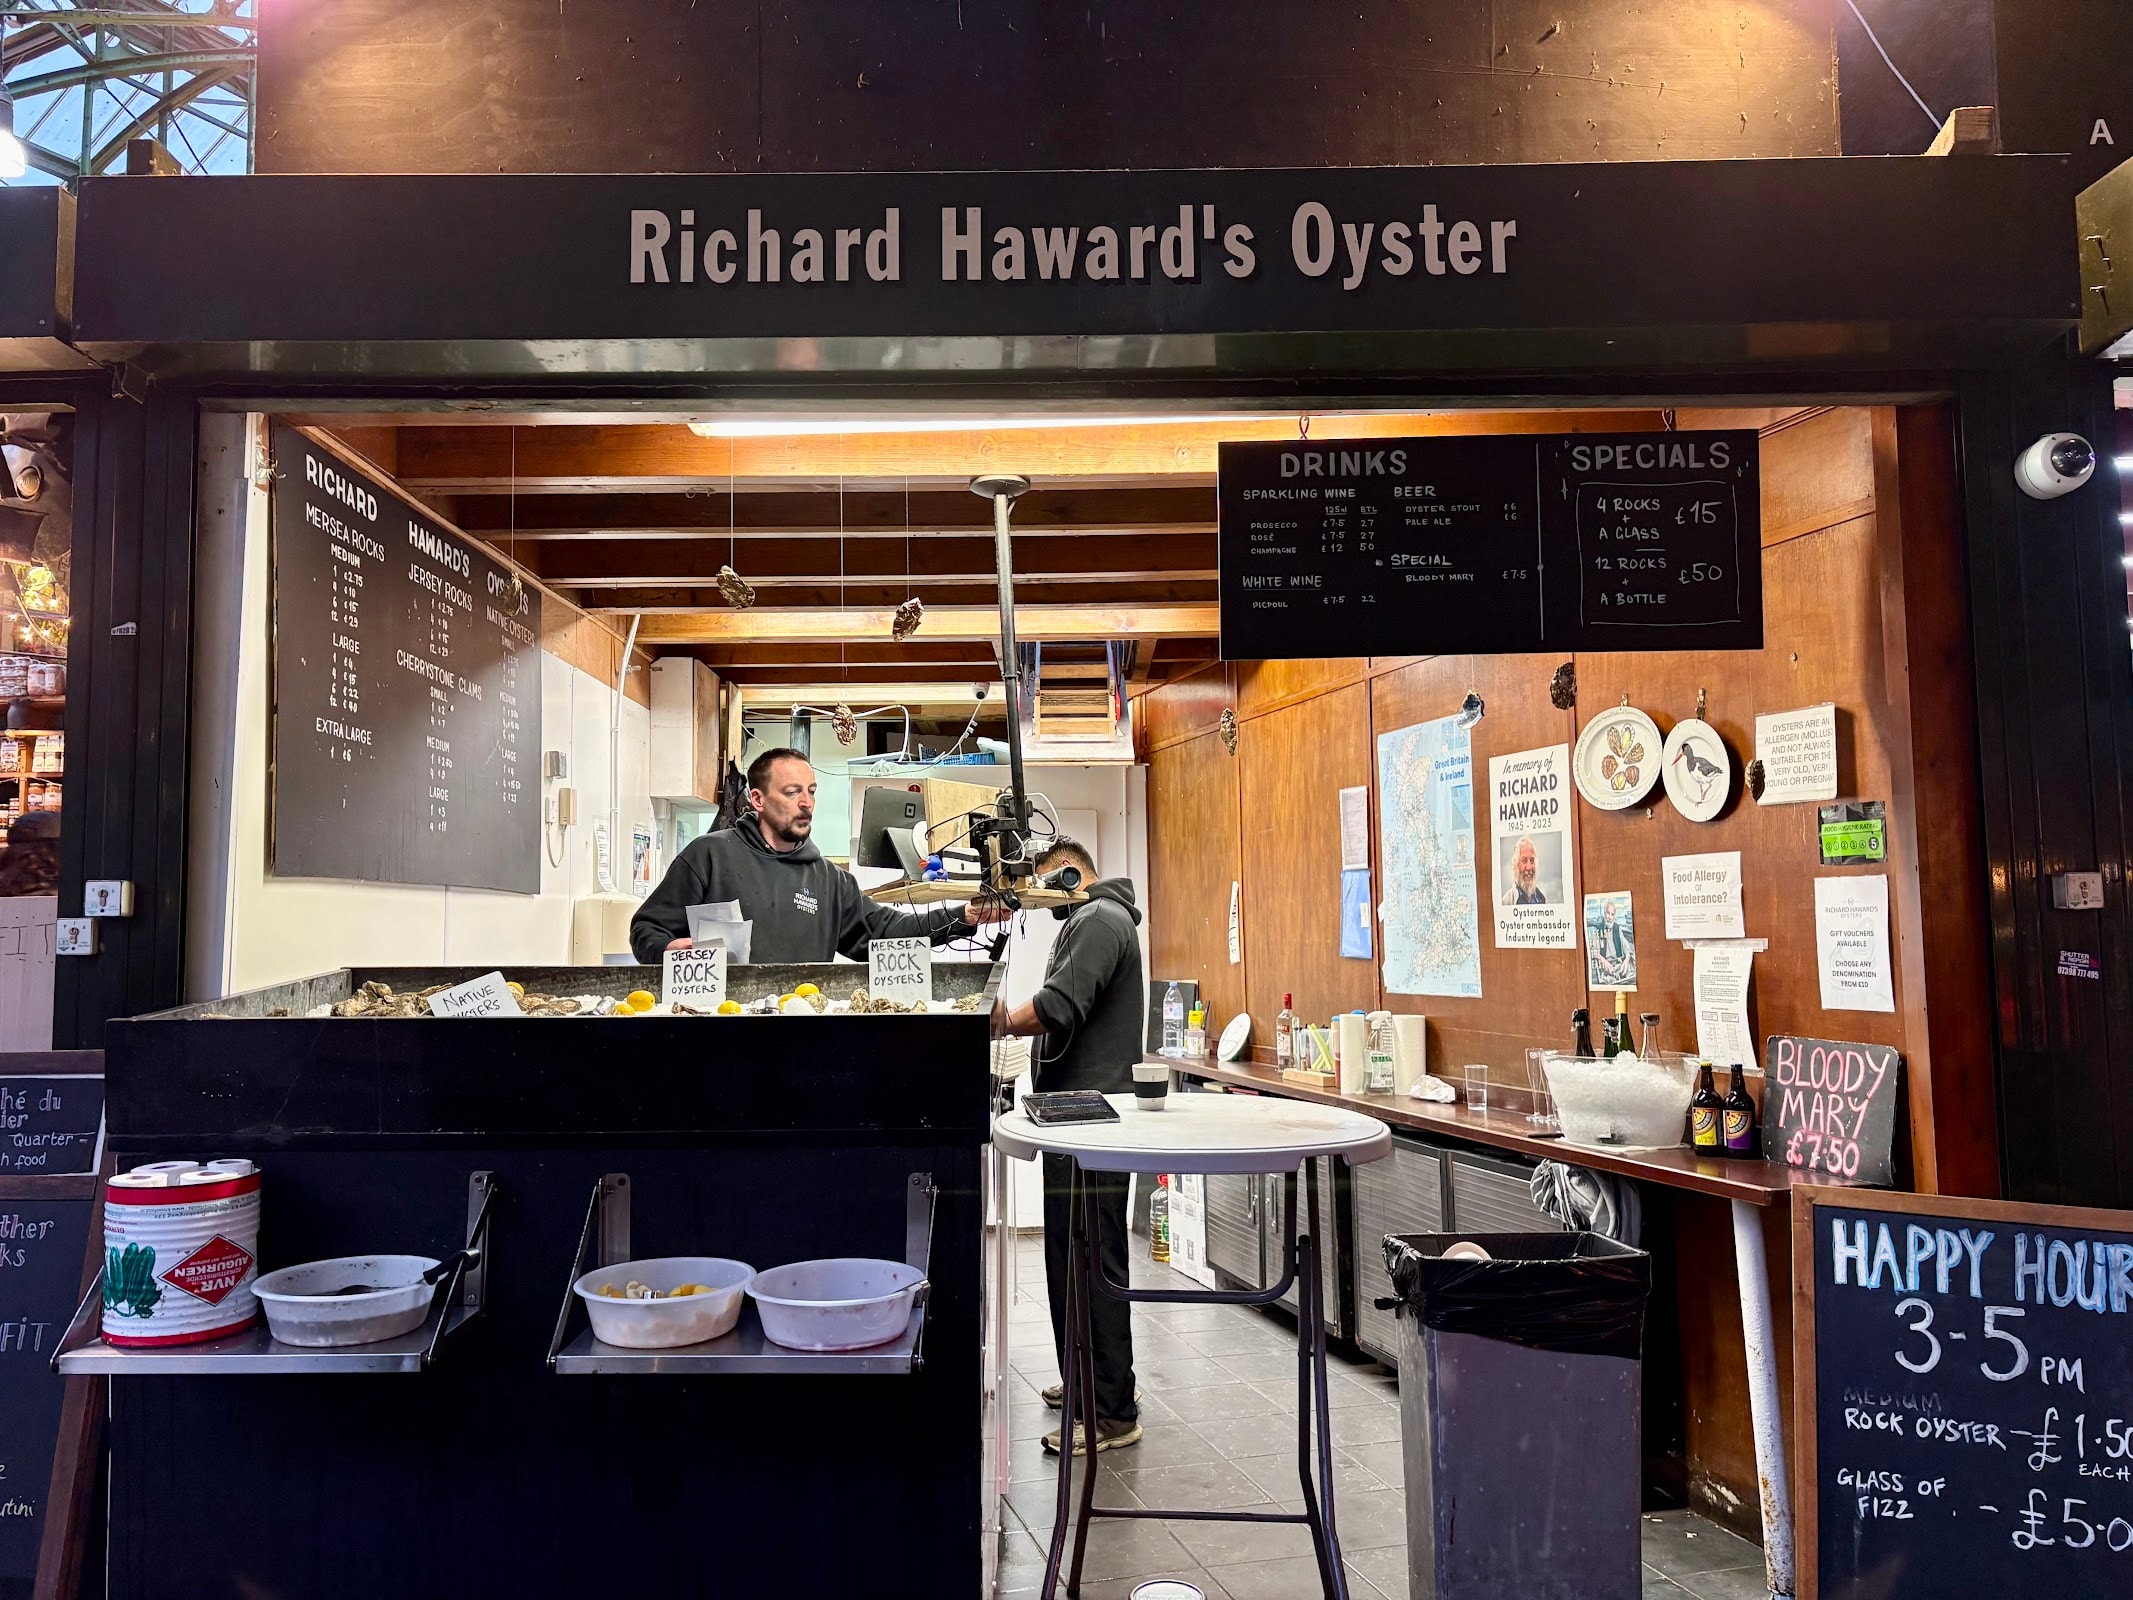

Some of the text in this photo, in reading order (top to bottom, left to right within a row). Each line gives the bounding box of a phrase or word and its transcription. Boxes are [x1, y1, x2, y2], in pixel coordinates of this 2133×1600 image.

[2089, 118, 2114, 145] A
[630, 200, 1517, 291] Richard Haward's Oyster
[1280, 449, 1408, 479] DRINKS
[1571, 441, 1730, 472] SPECIALS
[305, 453, 378, 522] RICHARD
[1242, 487, 1357, 501] SPARKLING WINE
[1393, 485, 1437, 498] BEER
[1360, 505, 1378, 513] BTL
[1405, 504, 1446, 514] OYSTER
[1450, 503, 1481, 513] STOUT
[1596, 497, 1723, 525] 4 ROCKS £15
[1250, 521, 1298, 530] PROSECCO
[1360, 519, 1375, 528] 27
[1405, 517, 1430, 526] PALE
[1433, 517, 1452, 526] ALE
[305, 501, 385, 562] MERSEA ROCKS
[1360, 531, 1375, 540] 27
[1599, 526, 1660, 542] A GLASS
[330, 542, 360, 568] MEDIUM
[408, 520, 471, 578] HAWARD'S
[1250, 546, 1297, 555] CHAMPAGNE
[1359, 542, 1375, 551] 50
[1390, 554, 1453, 567] SPECIAL
[1595, 556, 1667, 570] 12 ROCKS
[1242, 575, 1323, 589] WHITE WINE
[1405, 573, 1445, 583] BLOODY
[1448, 572, 1475, 582] MARY
[1678, 562, 1723, 585] £50
[408, 562, 472, 612] JERSEY ROCKS
[1252, 600, 1289, 609] PICPOUL
[1361, 594, 1377, 604] 22
[1600, 593, 1667, 606] A BOTTLE
[486, 604, 535, 648] NATIVE OYSTERS
[332, 632, 360, 654] LARGE
[396, 648, 482, 701] CHERRYSTONE CLAMS
[430, 685, 448, 703] SMALL
[316, 716, 372, 746] EXTRA LARGE
[1772, 716, 1830, 734] OYSTERS ARE AN
[426, 735, 450, 753] MEDIUM
[1764, 731, 1801, 745] ALLERGEN
[1771, 739, 1831, 755] AND NOT ALWAYS
[1434, 753, 1471, 771] Great Britain
[1502, 751, 1554, 775] In memory of
[1770, 750, 1832, 766] SUITABLE FOR THE
[1439, 769, 1465, 783] & Ireland
[1773, 762, 1829, 777] VERY OLD, VERY
[1499, 772, 1558, 799] RICHARD
[1766, 776, 1789, 788] YOUNG
[1790, 775, 1801, 786] OR
[429, 785, 449, 802] LARGE
[1499, 797, 1559, 822] HAWARD
[1508, 819, 1524, 832] 1945
[1532, 817, 1552, 830] 2023
[1672, 870, 1727, 884] Food Allergy
[1694, 884, 1702, 892] or
[1673, 891, 1728, 906] Intolerance?
[1512, 907, 1555, 921] Oysterman
[1500, 920, 1571, 933] Oyster ambassdor
[1829, 930, 1875, 938] GIFT VOUCHERS
[870, 938, 928, 952] MERSEA
[1505, 932, 1566, 945] Industry legend
[1836, 940, 1867, 948] AVAILABLE
[671, 948, 718, 963] JERSEY
[876, 951, 922, 974] ROCK
[1835, 960, 1872, 968] CHOOSE ANY
[672, 962, 720, 984] ROCK
[873, 972, 925, 987] OYSTERS
[1832, 970, 1877, 978] DENOMINATION
[671, 983, 717, 995] OYSTERS
[1840, 980, 1858, 988] FROM
[442, 984, 496, 1012] NATIVE
[451, 999, 501, 1017] YSTERS
[1776, 1038, 1891, 1100] BLOODY
[39, 1089, 61, 1111] du
[1778, 1087, 1870, 1140] MARY
[13, 1131, 74, 1147] Quarter
[14, 1151, 47, 1170] food
[1785, 1130, 1861, 1178] £7.50
[174, 1254, 249, 1279] AUGURKEN
[1832, 1217, 2133, 1314] HAPPY HOUR
[200, 1274, 236, 1294] NVR
[2040, 1356, 2086, 1395] PM
[1844, 1407, 1904, 1437] ROCK
[1915, 1416, 2007, 1451] OYSTER
[2079, 1463, 2132, 1482] EACH
[1837, 1467, 1947, 1498] GLASS OF
[1857, 1487, 2133, 1552] FIZZ £5.0
